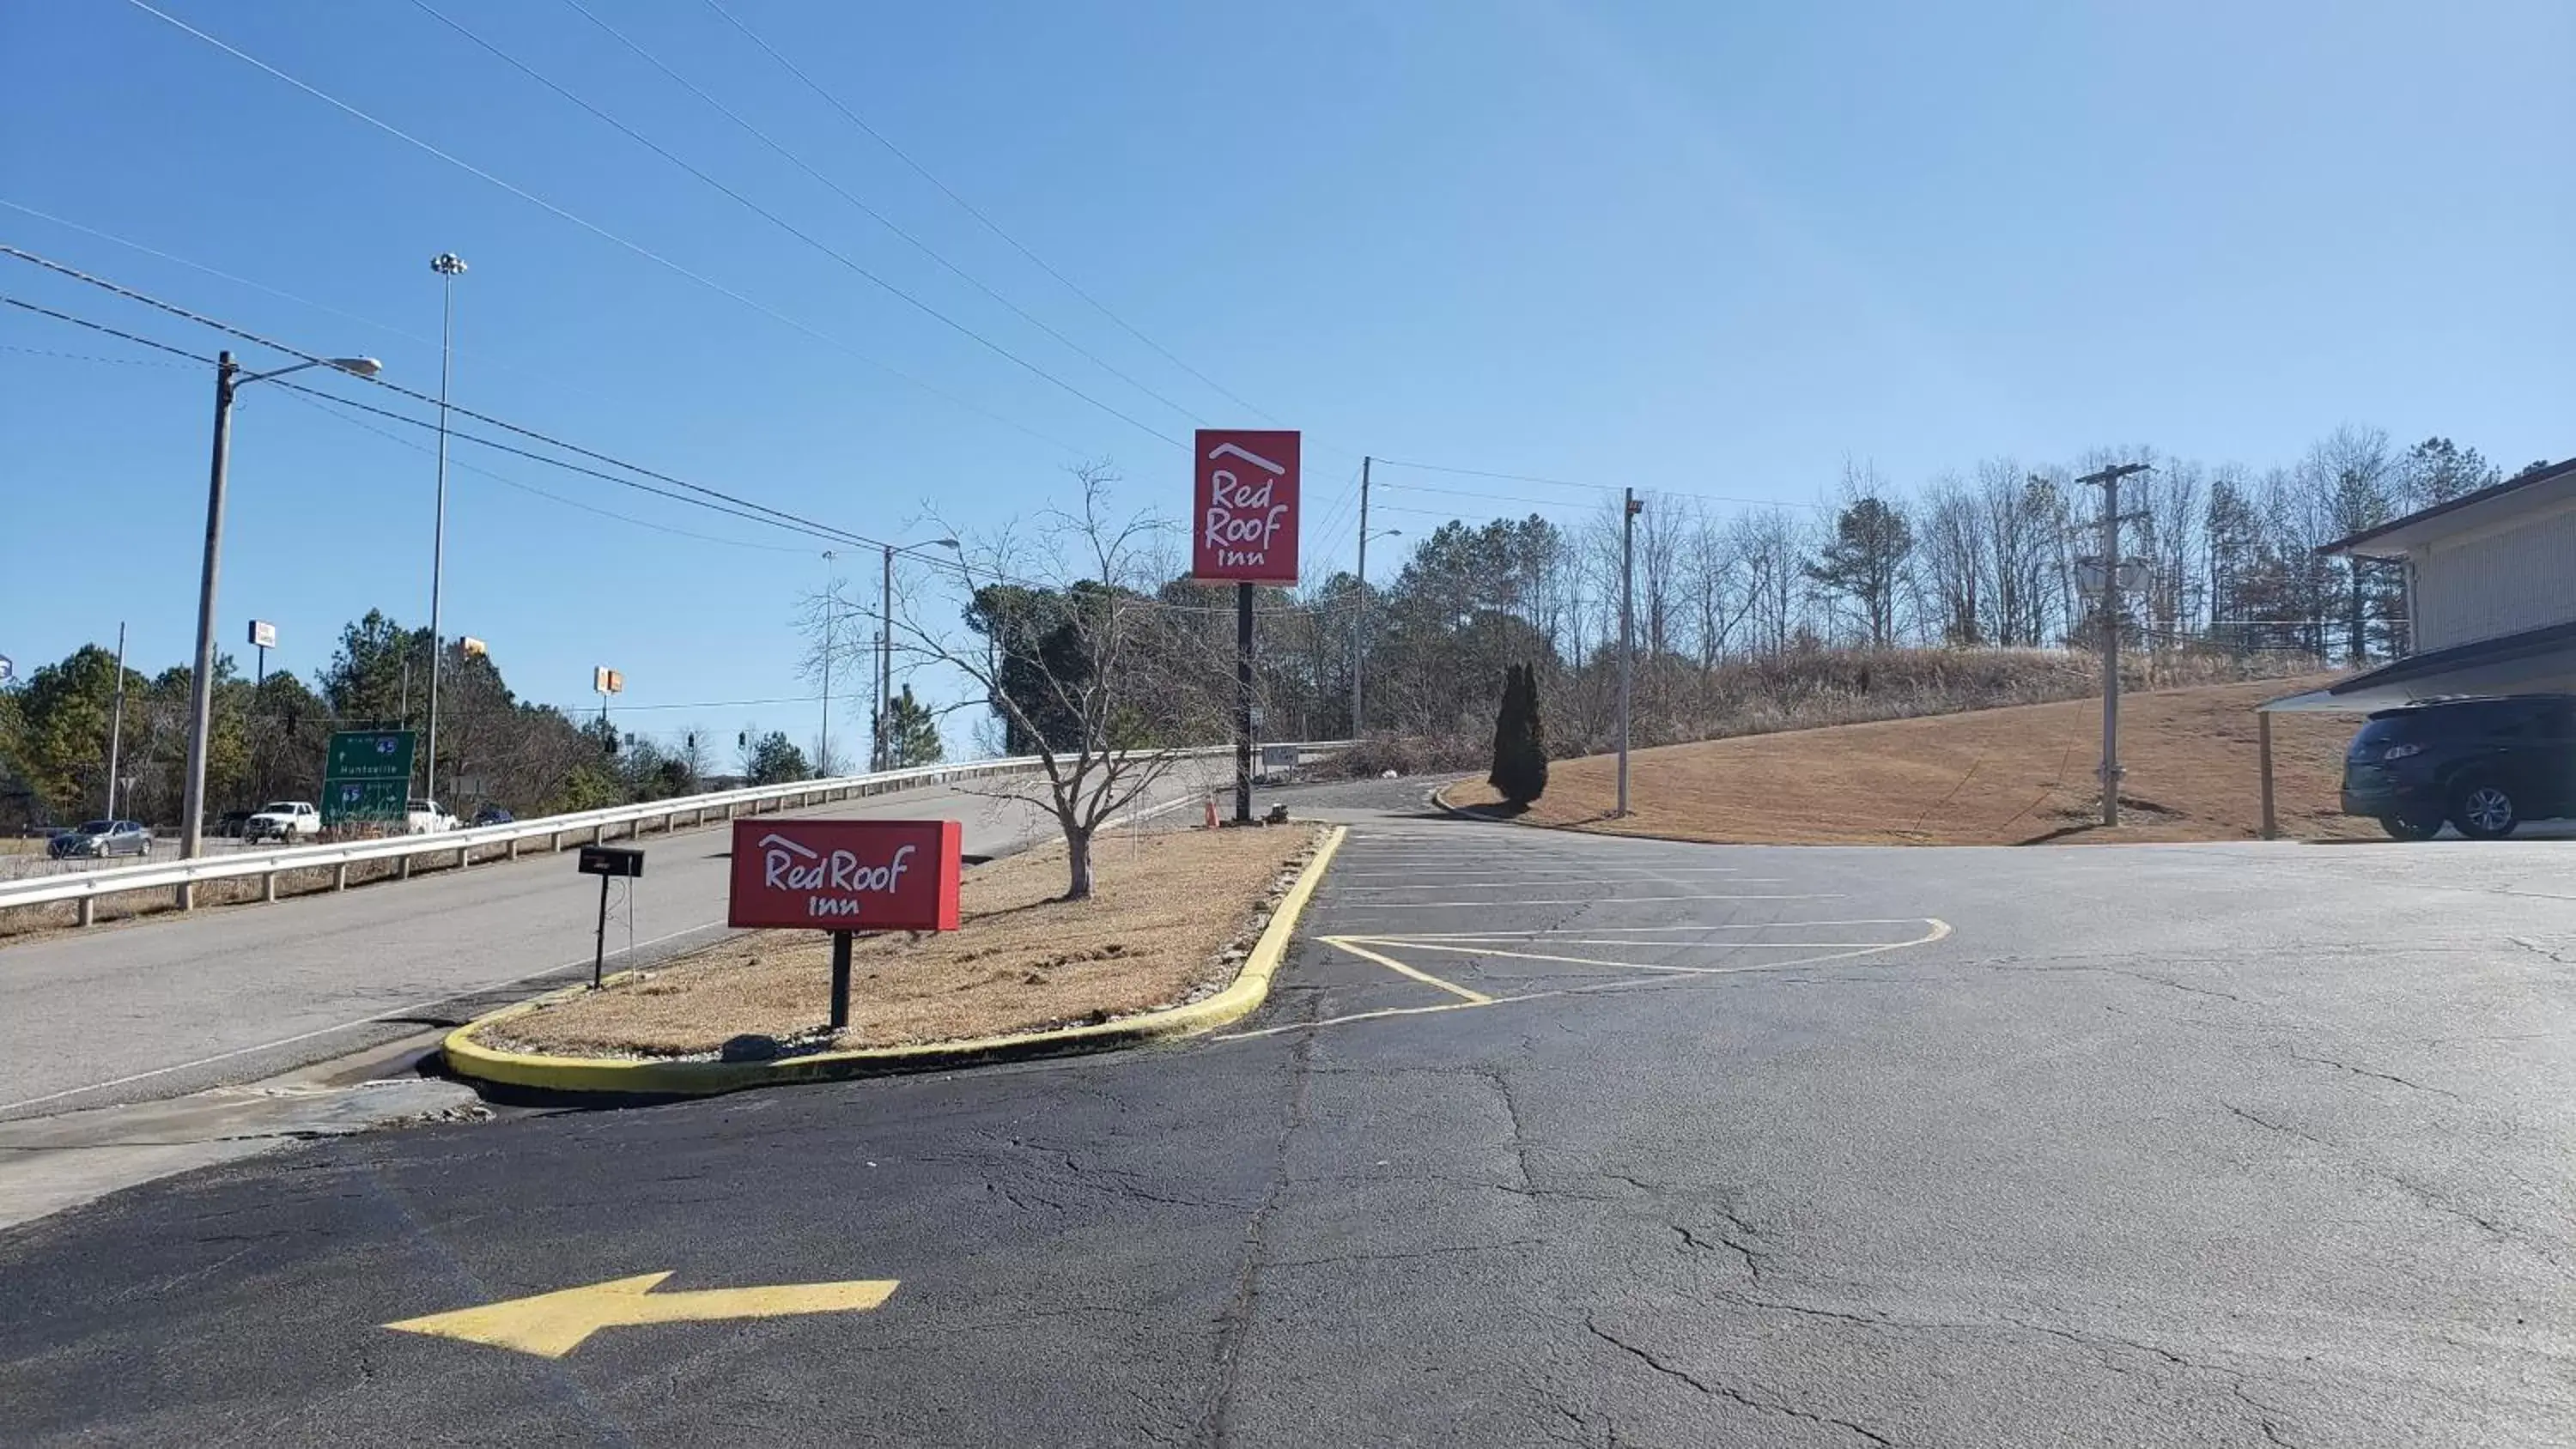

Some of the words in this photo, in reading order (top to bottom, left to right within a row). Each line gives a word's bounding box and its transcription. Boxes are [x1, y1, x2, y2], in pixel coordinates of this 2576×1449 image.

[1212, 470, 1273, 509] Red
[1205, 504, 1289, 550] Roof
[340, 764, 398, 776] Huntsville
[765, 848, 829, 891] Red
[830, 845, 916, 894] Roof
